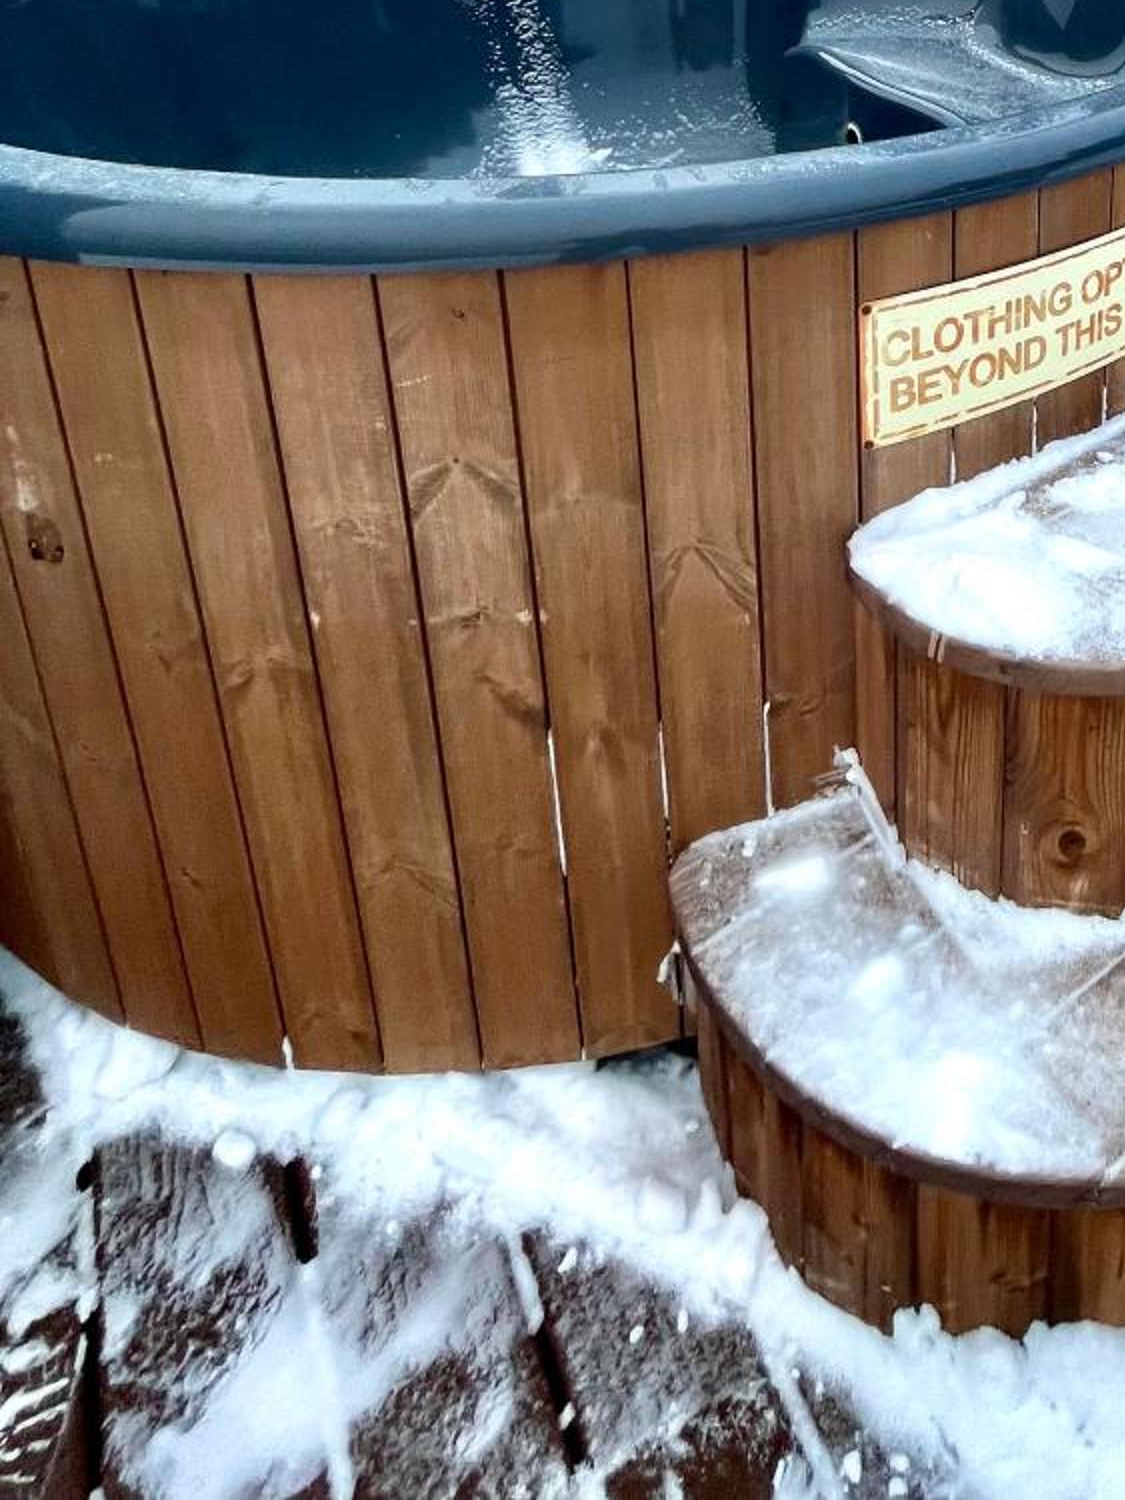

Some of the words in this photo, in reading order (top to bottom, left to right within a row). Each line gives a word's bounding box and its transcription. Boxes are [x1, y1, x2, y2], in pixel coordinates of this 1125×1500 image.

[882, 282, 1073, 367] CLOTHING
[889, 335, 1047, 414] BEYOND
[1056, 303, 1122, 357] THIS
